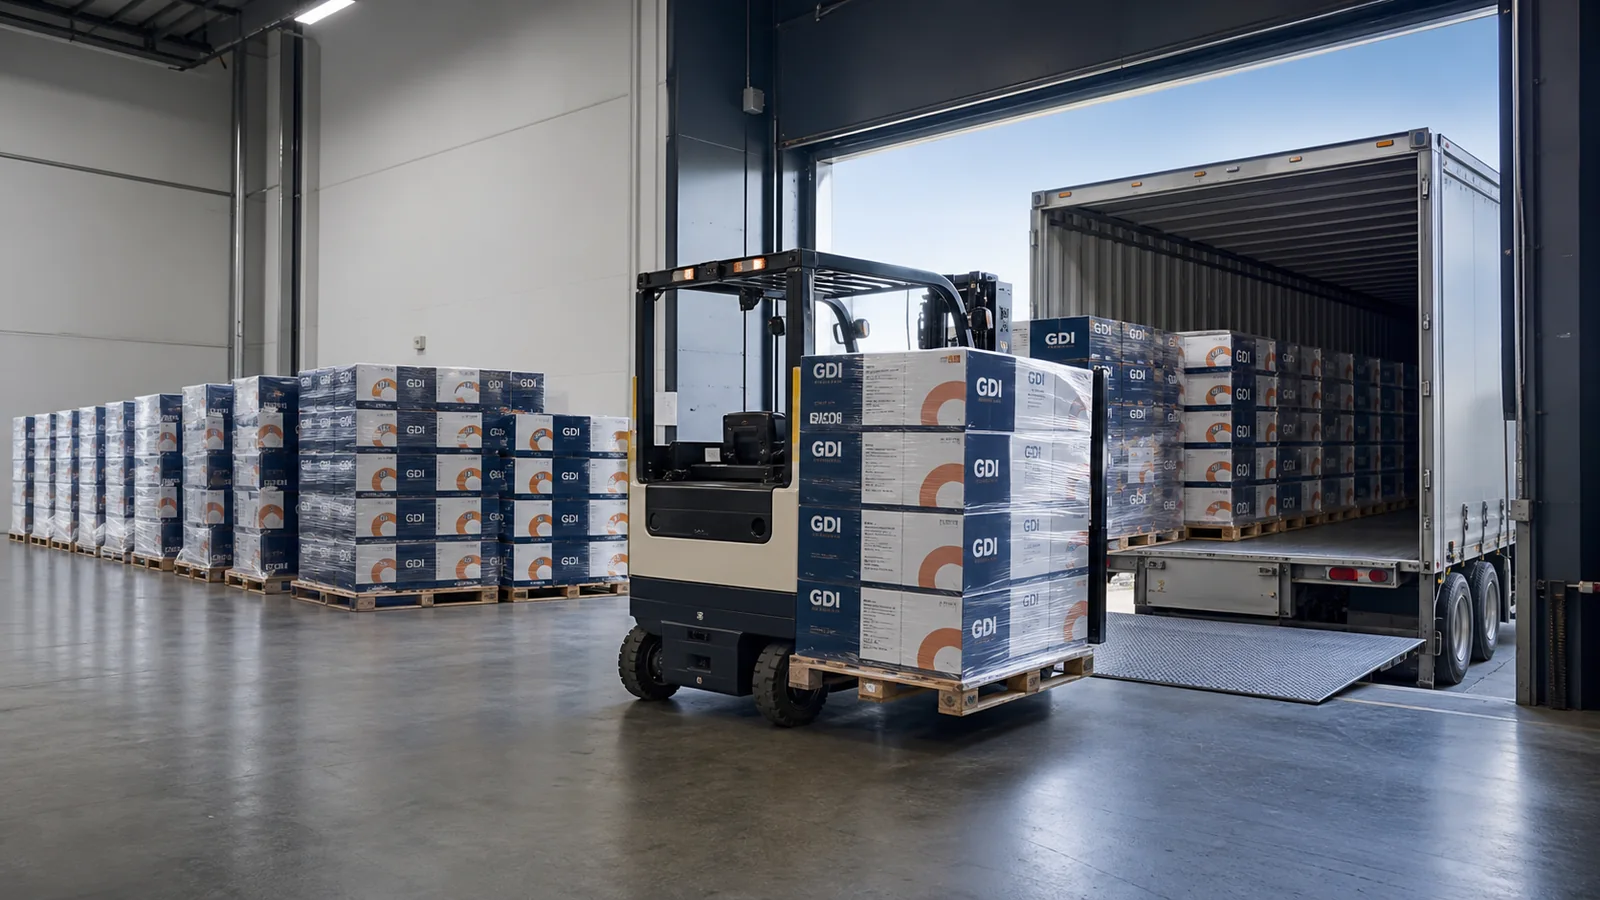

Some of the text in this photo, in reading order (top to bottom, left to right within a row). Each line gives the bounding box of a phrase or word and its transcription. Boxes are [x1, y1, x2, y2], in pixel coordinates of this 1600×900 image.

[1094, 322, 1112, 336] GDI
[1129, 328, 1145, 341] GDI
[1045, 332, 1075, 346] GDI
[1236, 349, 1251, 364] GDI
[813, 363, 843, 379] GDI
[1129, 368, 1146, 380] GDI
[406, 379, 425, 388] GDI
[488, 380, 504, 389] GDI
[520, 379, 537, 388] GDI
[1028, 371, 1045, 386] GDI
[976, 377, 1002, 398] GDI
[1236, 388, 1251, 401] GDI
[1129, 409, 1146, 420] GDI
[406, 425, 425, 435] GDI
[562, 427, 580, 437] GDI
[1236, 424, 1250, 438] GDI
[811, 441, 842, 458] GDI
[406, 469, 425, 478] GDI
[974, 459, 999, 478] GDI
[1236, 463, 1250, 477] GDI
[561, 472, 579, 481] GDI
[405, 513, 425, 523] GDI
[561, 514, 579, 524] GDI
[810, 515, 841, 534] GDI
[1023, 519, 1040, 533] GDI
[972, 537, 998, 558] GDI
[405, 559, 425, 569] GDI
[561, 557, 579, 566] GDI
[809, 589, 841, 608] GDI
[1023, 593, 1039, 607] GDI
[971, 615, 997, 639] GDI
